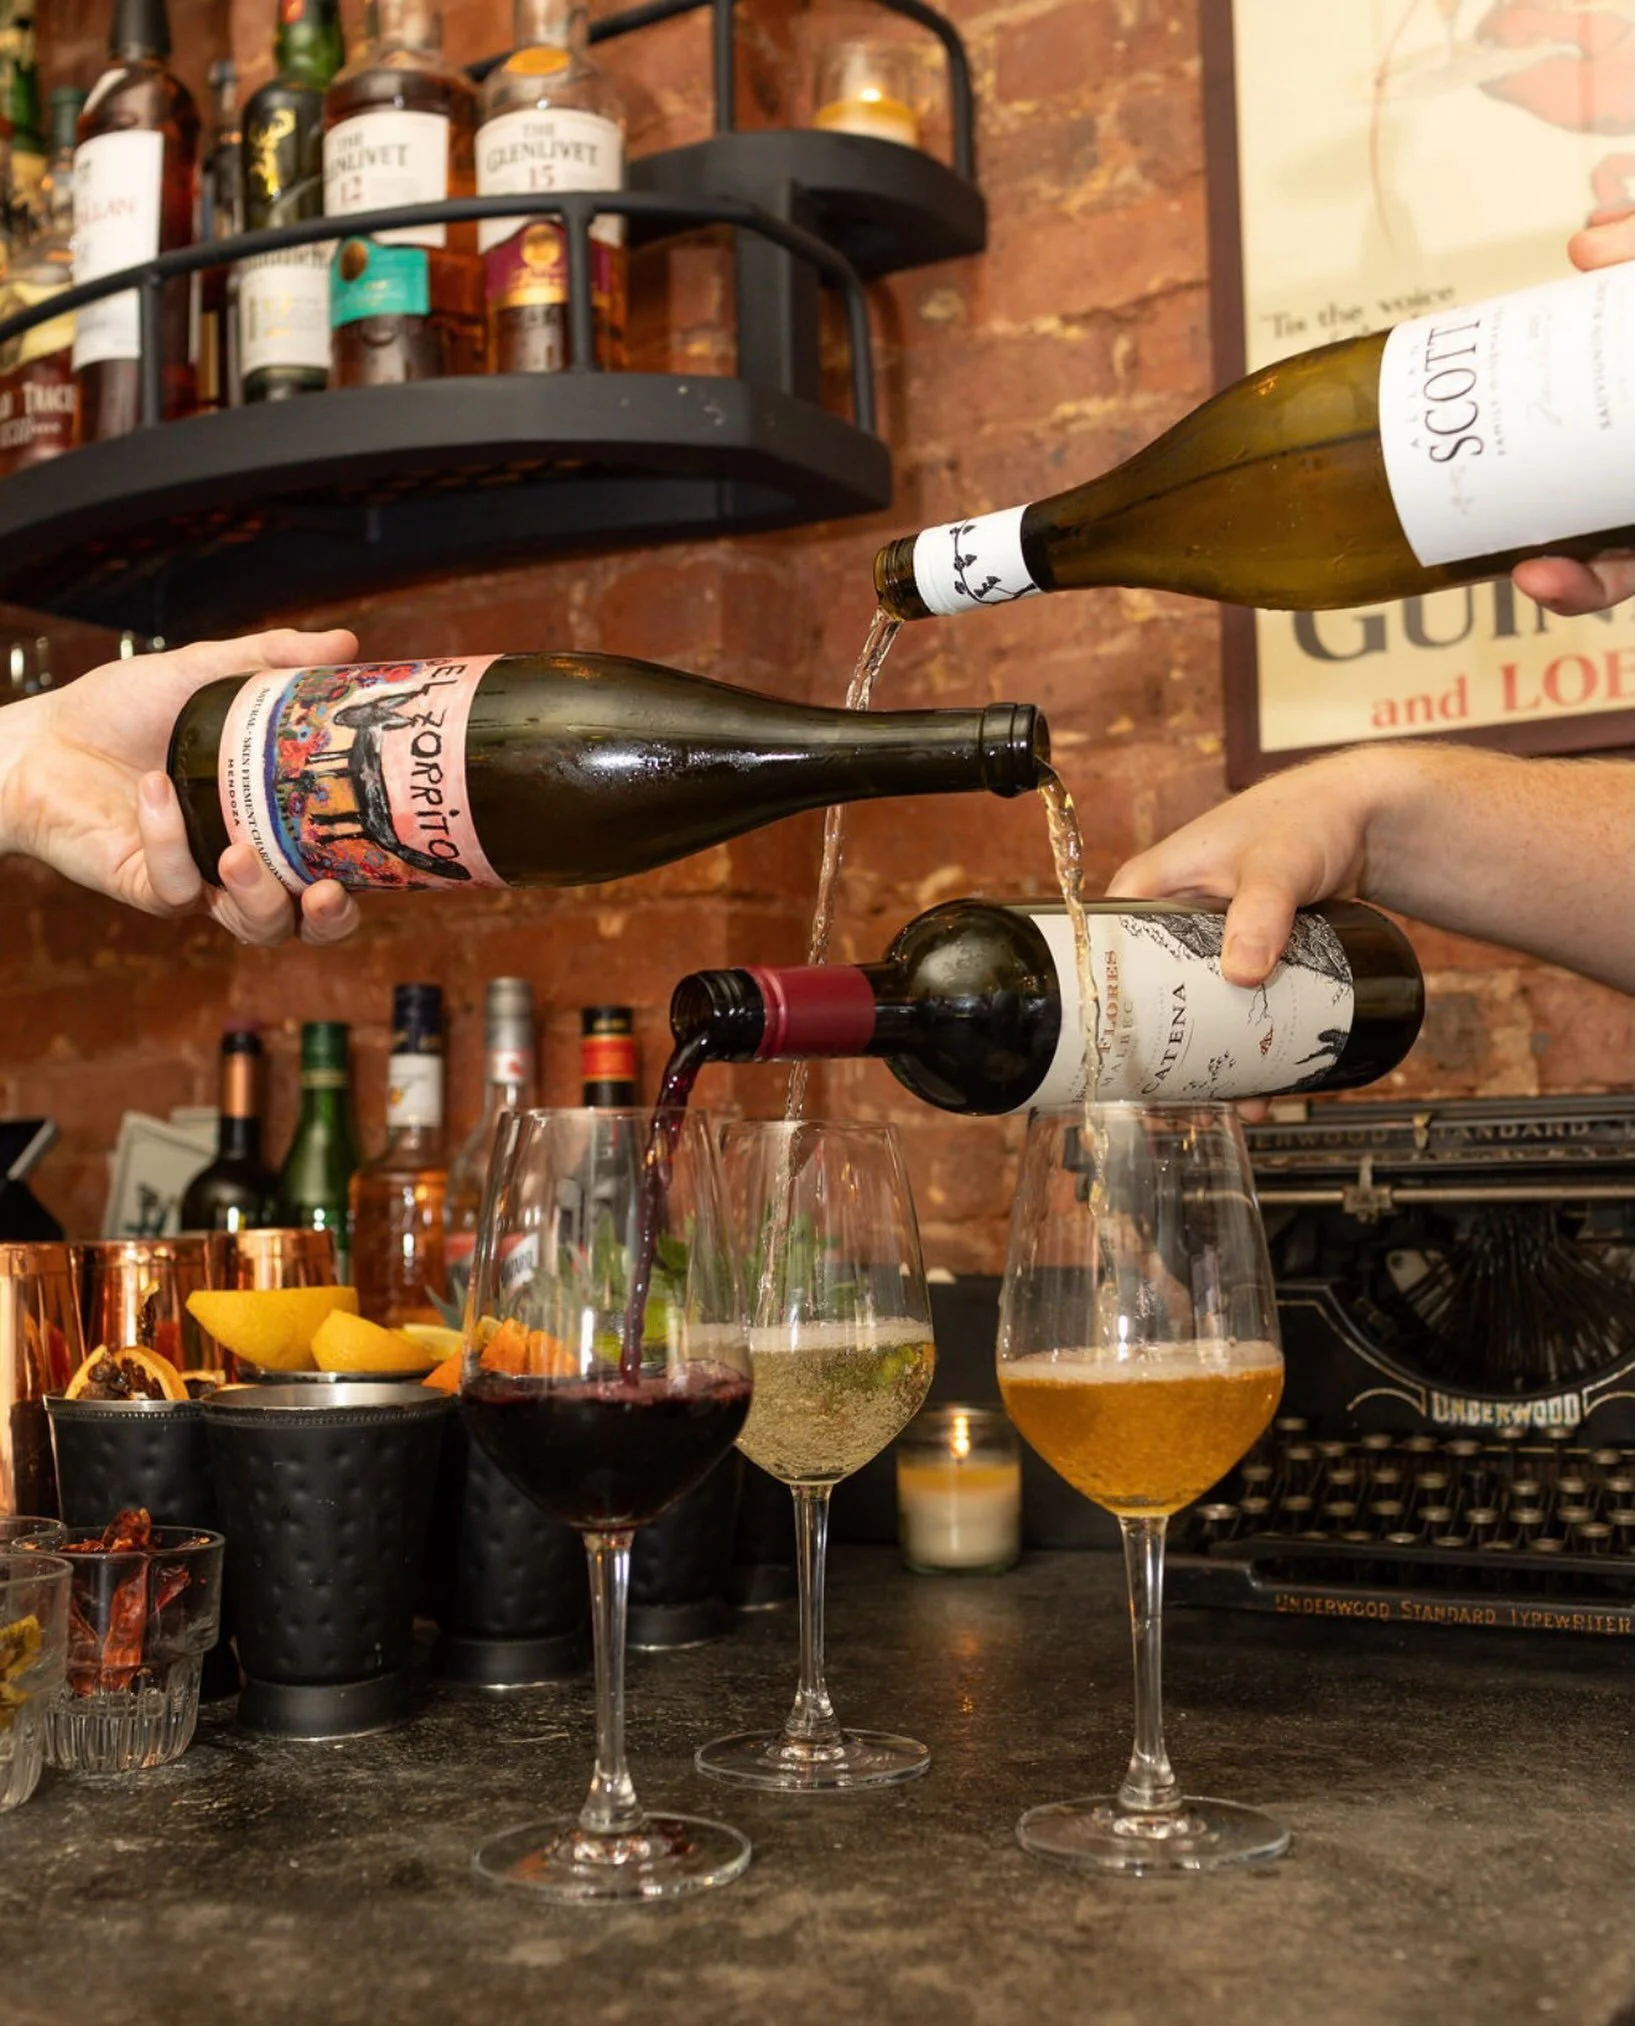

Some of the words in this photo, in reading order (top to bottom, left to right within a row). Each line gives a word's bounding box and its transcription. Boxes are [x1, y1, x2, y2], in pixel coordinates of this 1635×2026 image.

[486, 139, 600, 174] GLENLIVET
[1317, 303, 1363, 327] the
[1377, 287, 1455, 313] voice
[1422, 319, 1485, 464] SCOTT
[1370, 674, 1468, 729] and
[227, 758, 240, 828] MENDOZA
[1099, 950, 1119, 1054] FLORES
[1100, 1000, 1134, 1088] MALBEC
[1141, 983, 1188, 1095] CATENA
[1432, 1391, 1582, 1428] UNDERWOOD
[1274, 1593, 1391, 1620] UNDERWOOD
[1401, 1600, 1497, 1626] STANDARD
